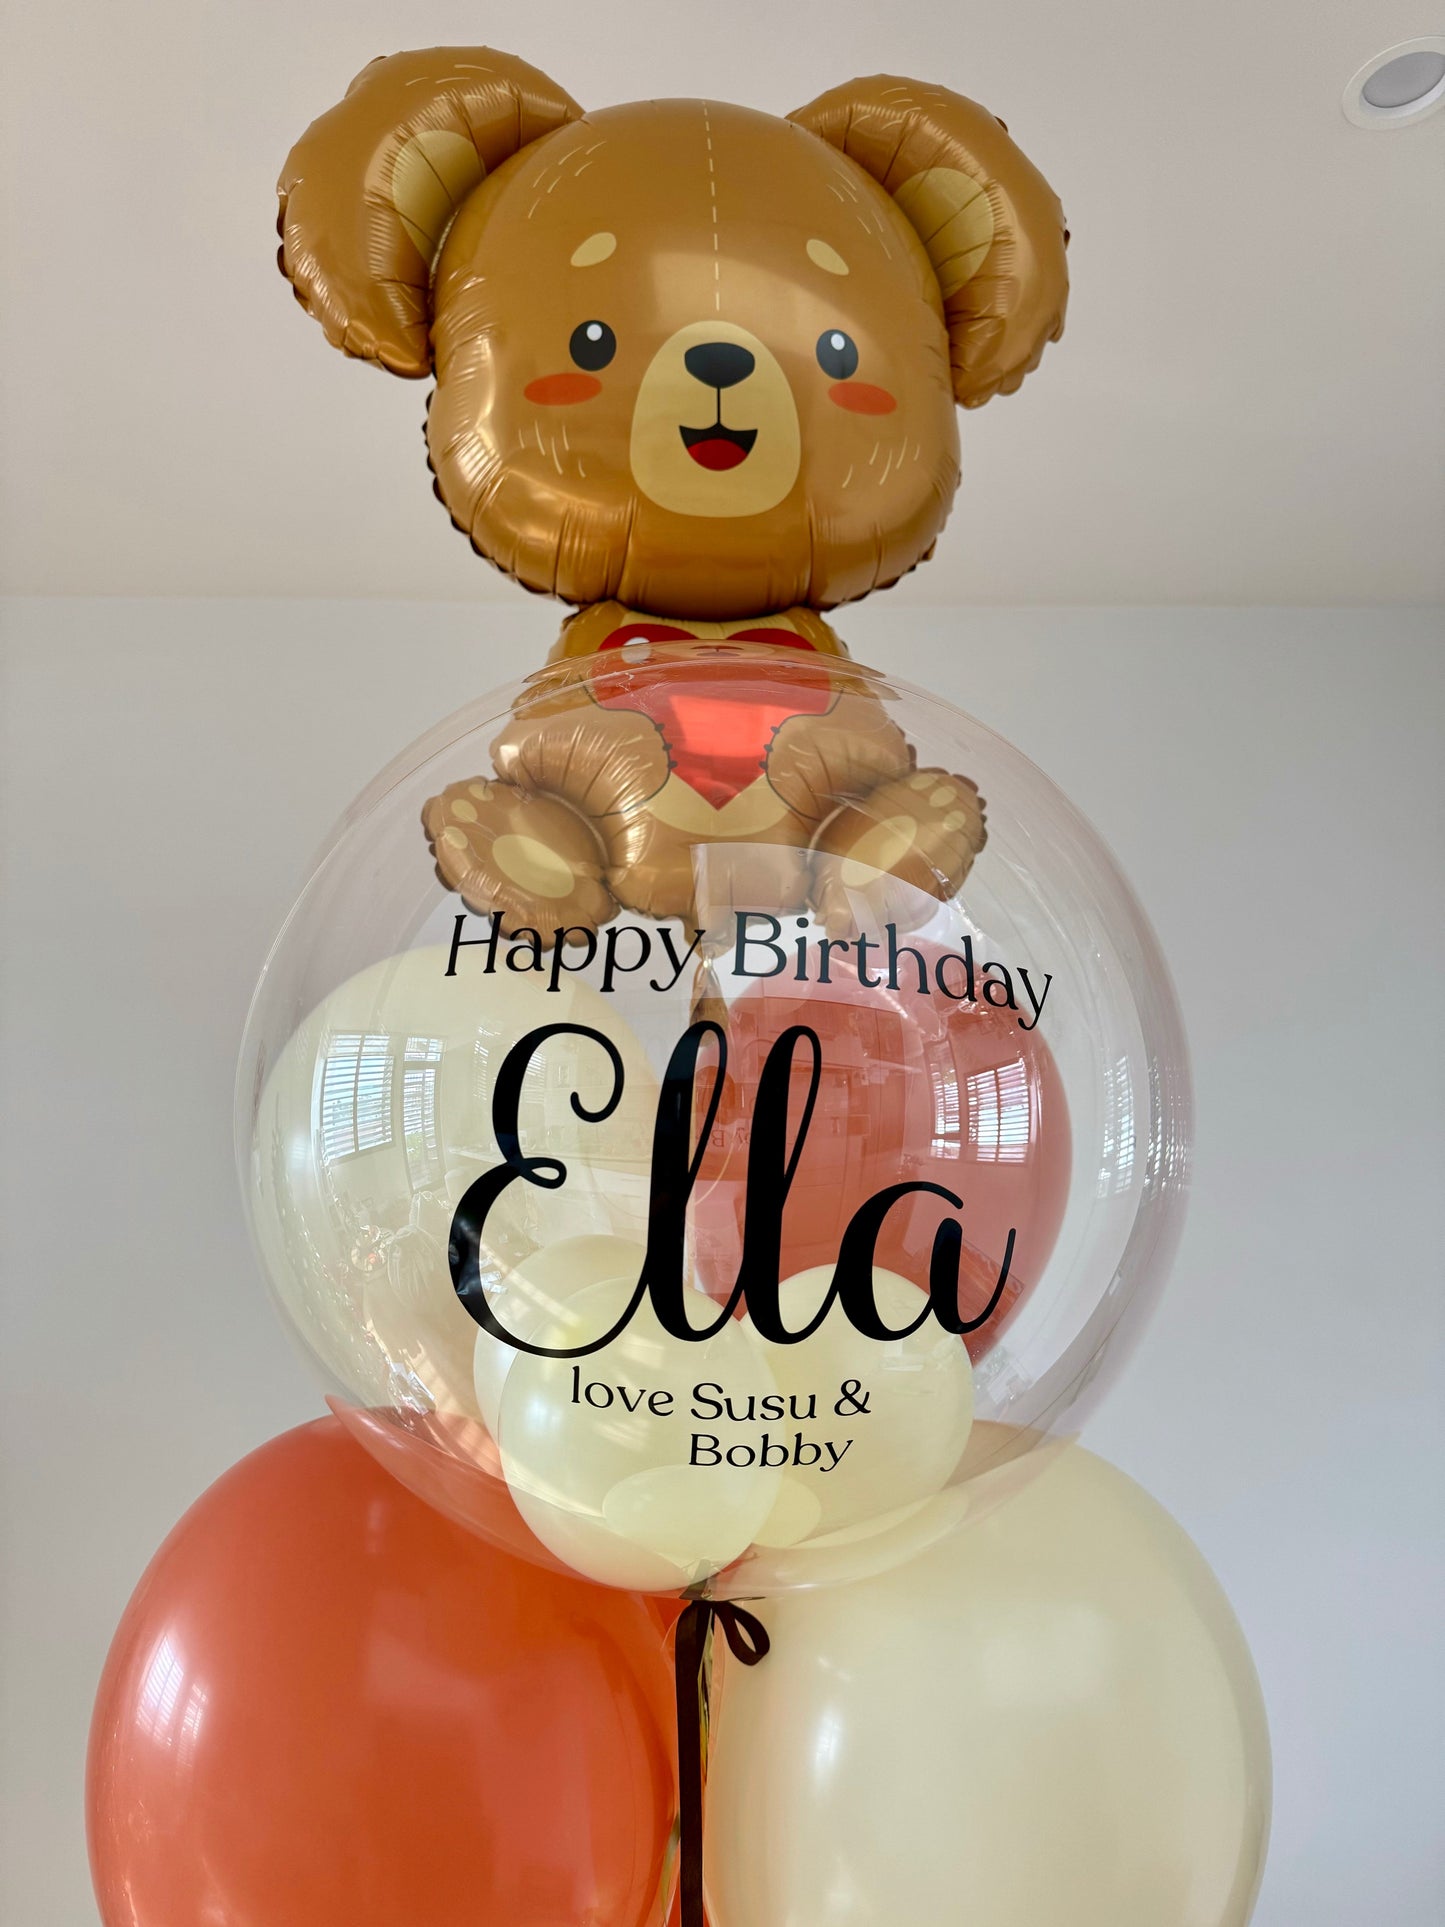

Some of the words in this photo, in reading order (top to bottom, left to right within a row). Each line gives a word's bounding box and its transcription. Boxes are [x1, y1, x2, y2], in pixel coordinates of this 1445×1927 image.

[443, 911, 705, 992] Happy
[730, 911, 1053, 1030] Birthday
[447, 1020, 1017, 1359] Ella
[570, 1365, 674, 1417] love
[690, 1382, 817, 1421] Susu
[833, 1379, 872, 1417] &
[688, 1432, 854, 1472] Bobby
